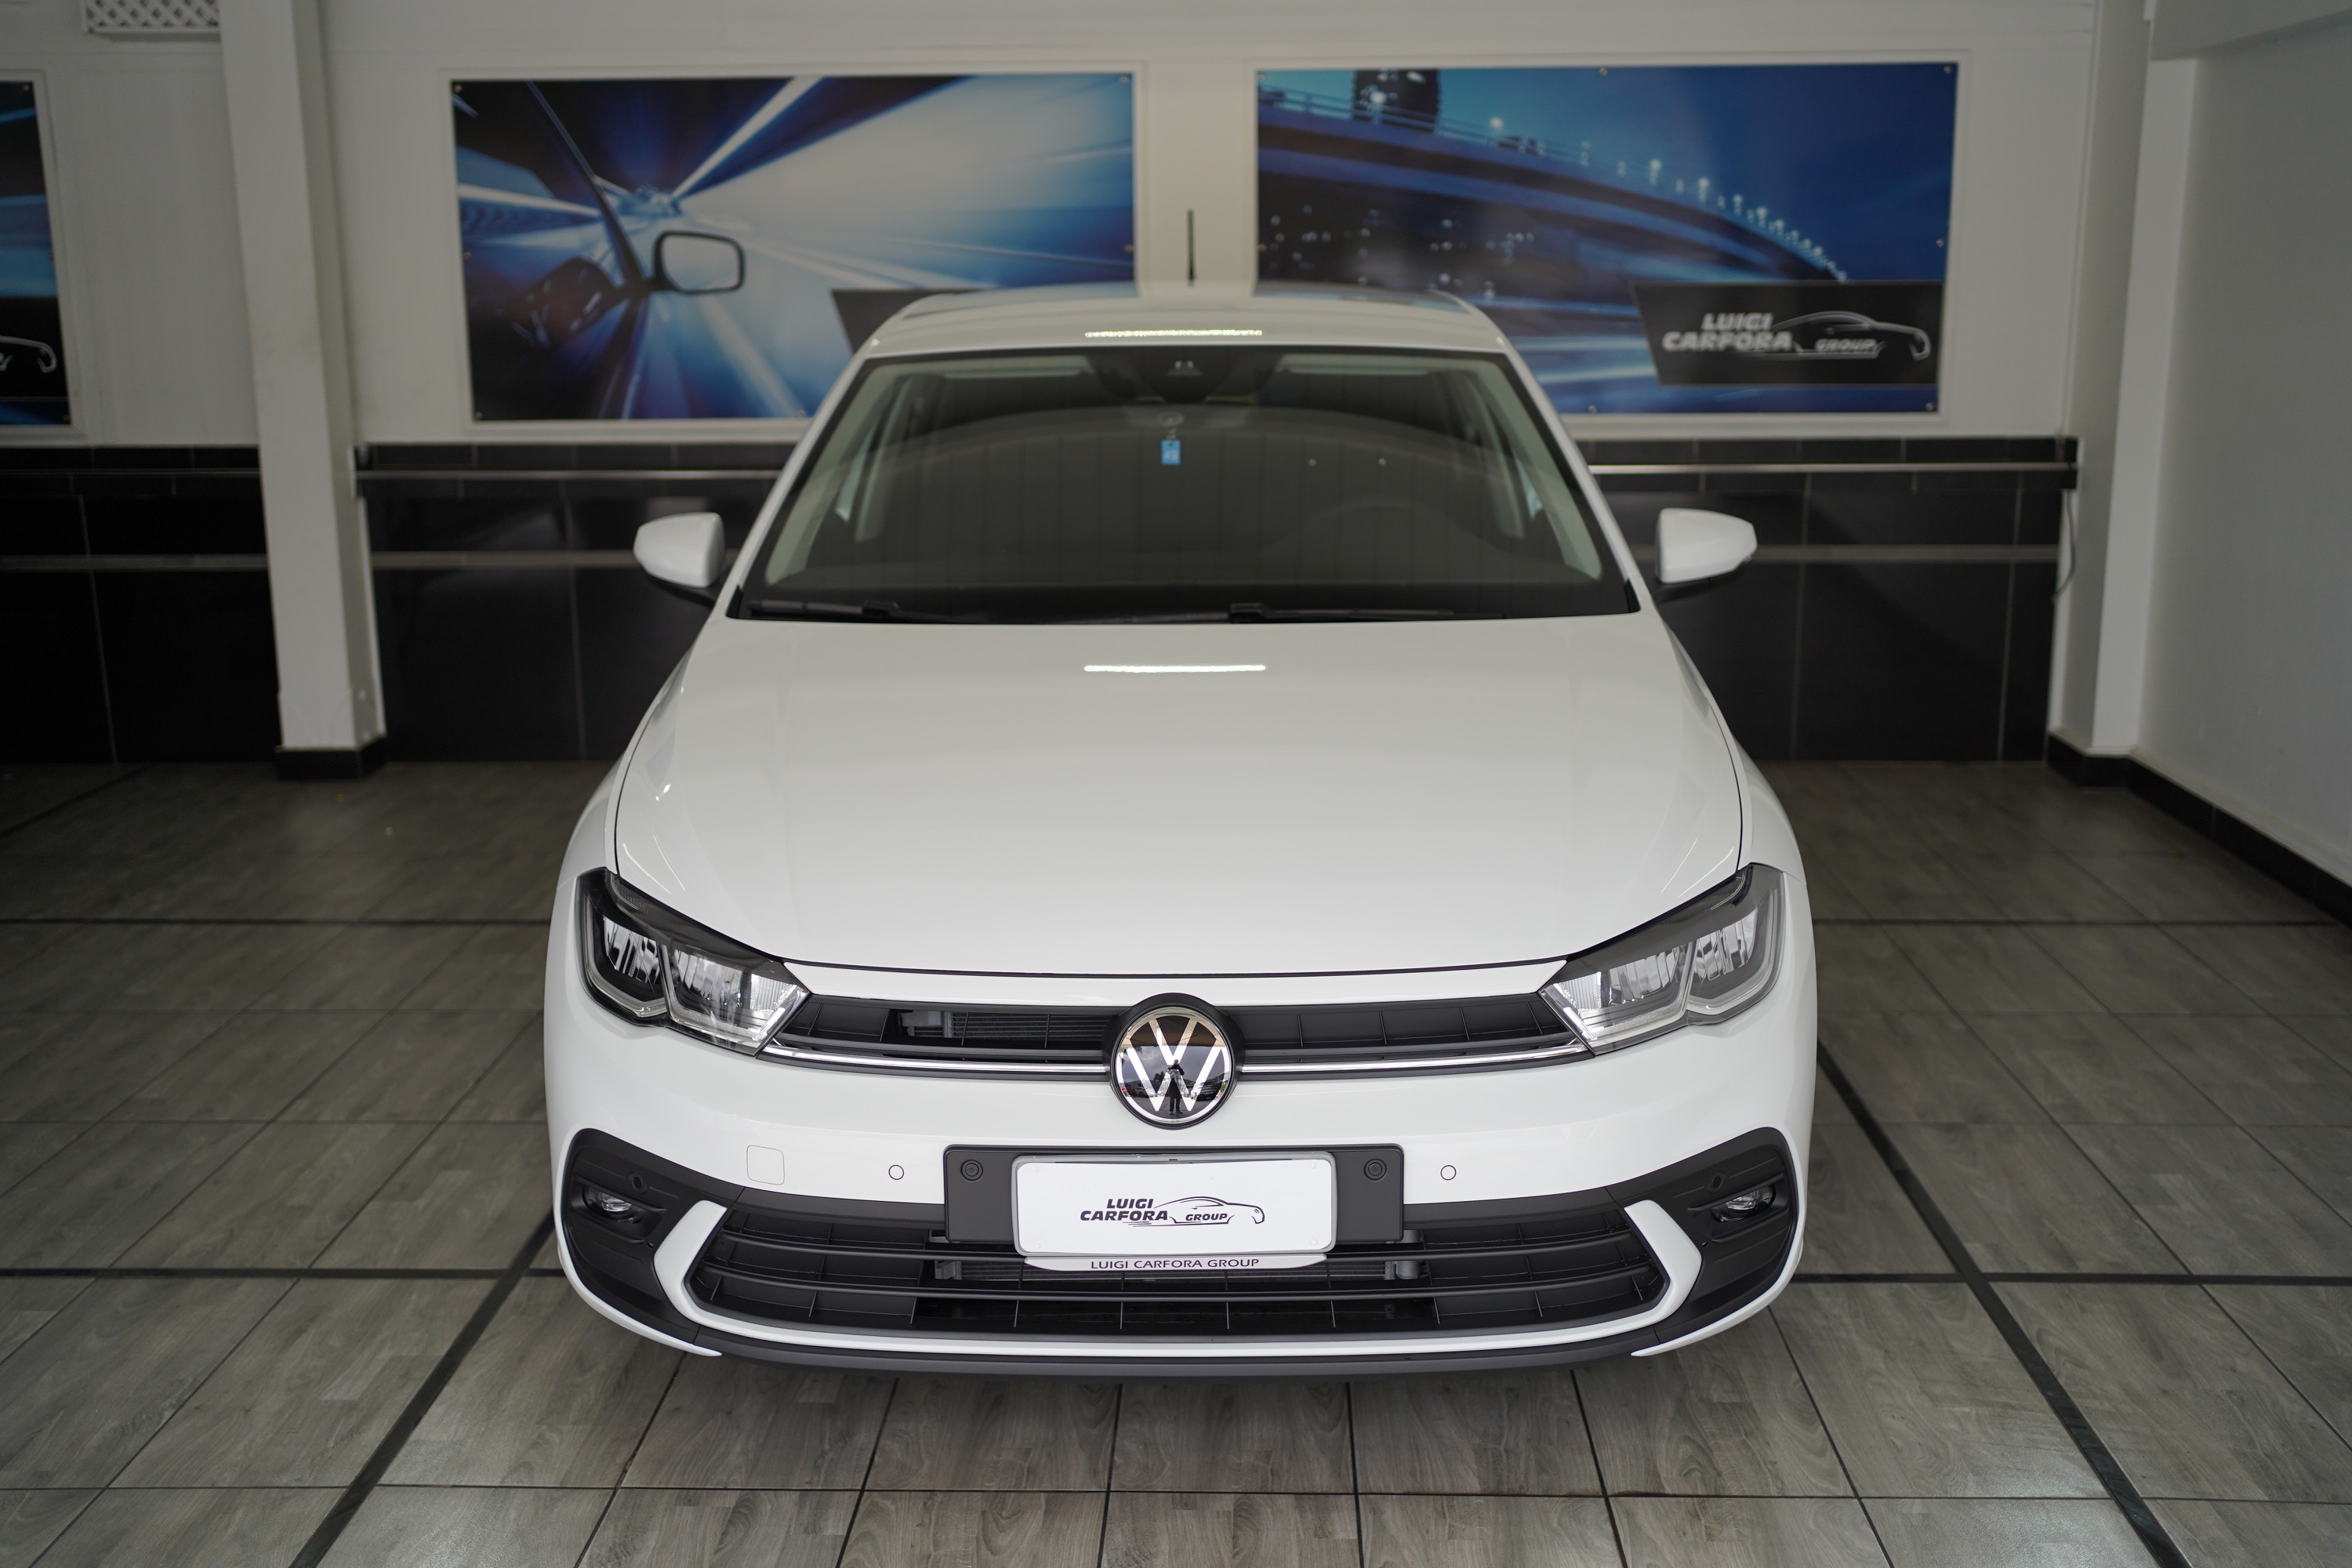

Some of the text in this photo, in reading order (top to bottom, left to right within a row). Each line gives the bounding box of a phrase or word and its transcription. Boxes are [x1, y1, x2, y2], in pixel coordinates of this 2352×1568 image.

[1700, 313, 1773, 331] LUIGI
[1661, 331, 1878, 351] CARFORA GROUP
[1106, 1198, 1154, 1210] LUIGI
[1080, 1210, 1228, 1221] CARFORA GROUP
[1091, 1258, 1260, 1269] LUIGI CARFORA GROUP
